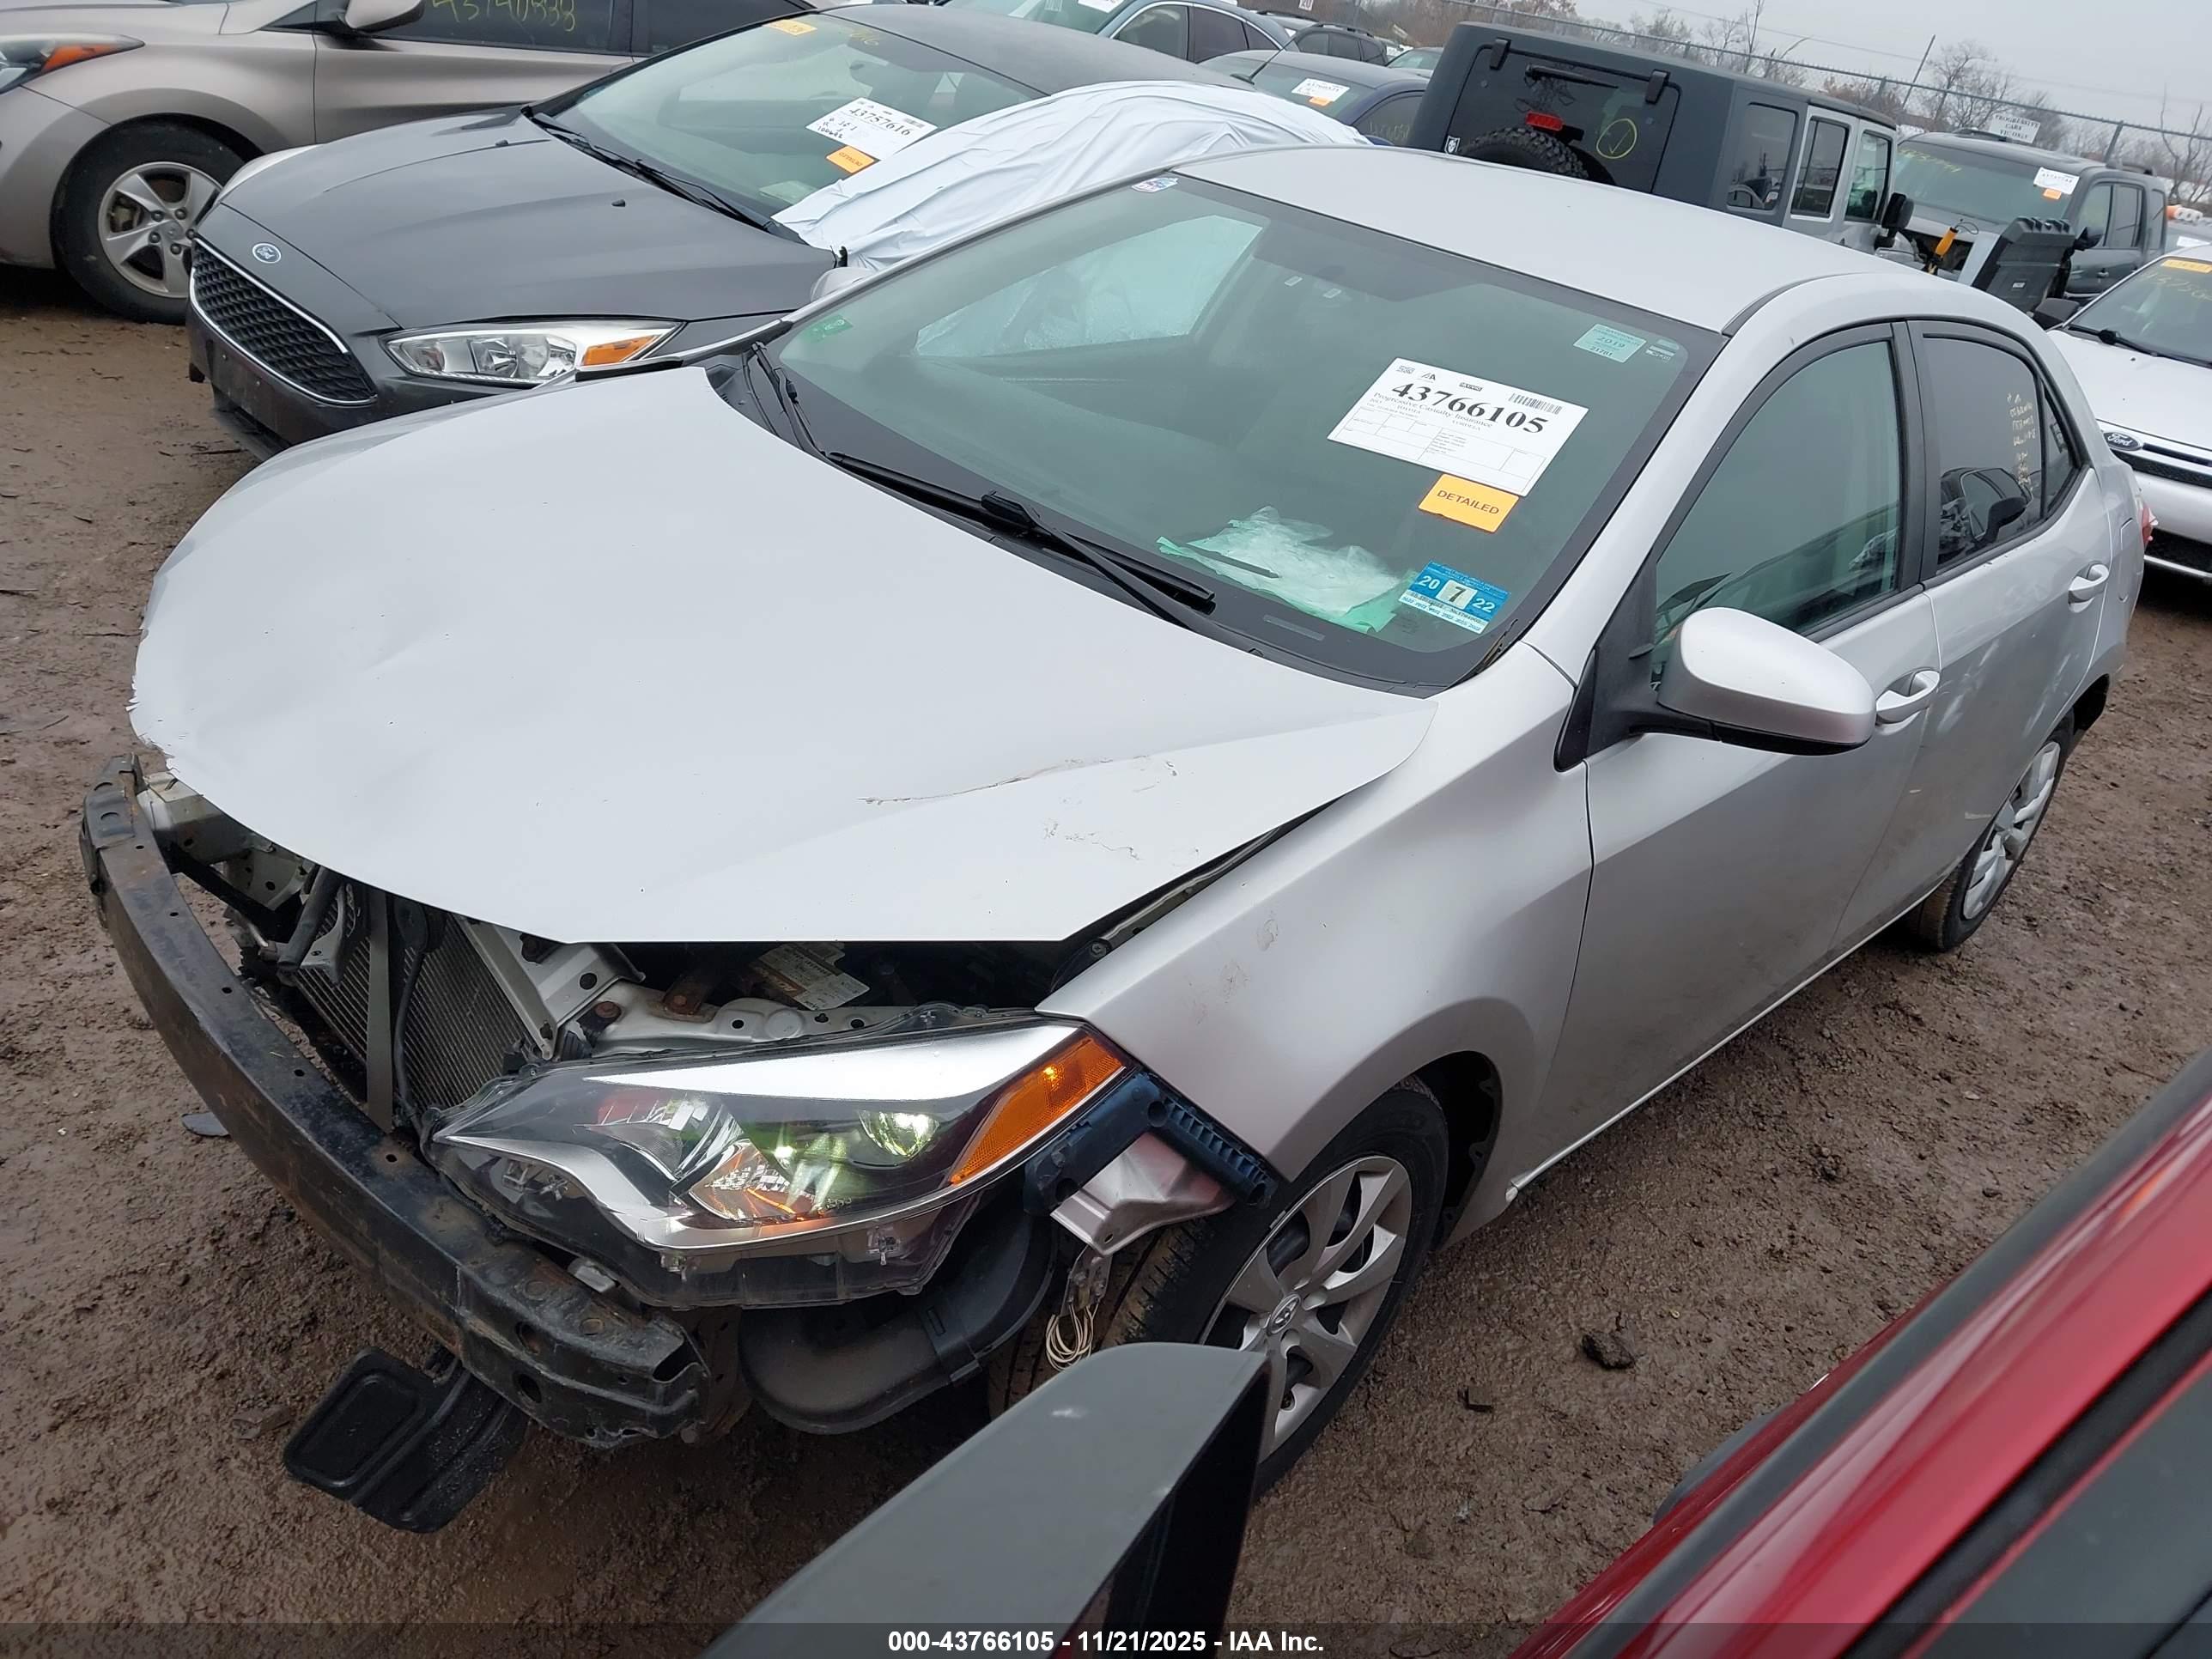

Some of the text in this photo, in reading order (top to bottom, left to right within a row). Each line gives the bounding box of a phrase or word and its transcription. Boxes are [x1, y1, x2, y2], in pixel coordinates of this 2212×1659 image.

[1391, 382, 1548, 434] 43766105
[2107, 433, 2133, 447] Ford
[1437, 489, 1499, 515] DETAILED
[1418, 574, 1441, 590] 20
[1449, 586, 1467, 603] 7
[1471, 598, 1495, 613] 22
